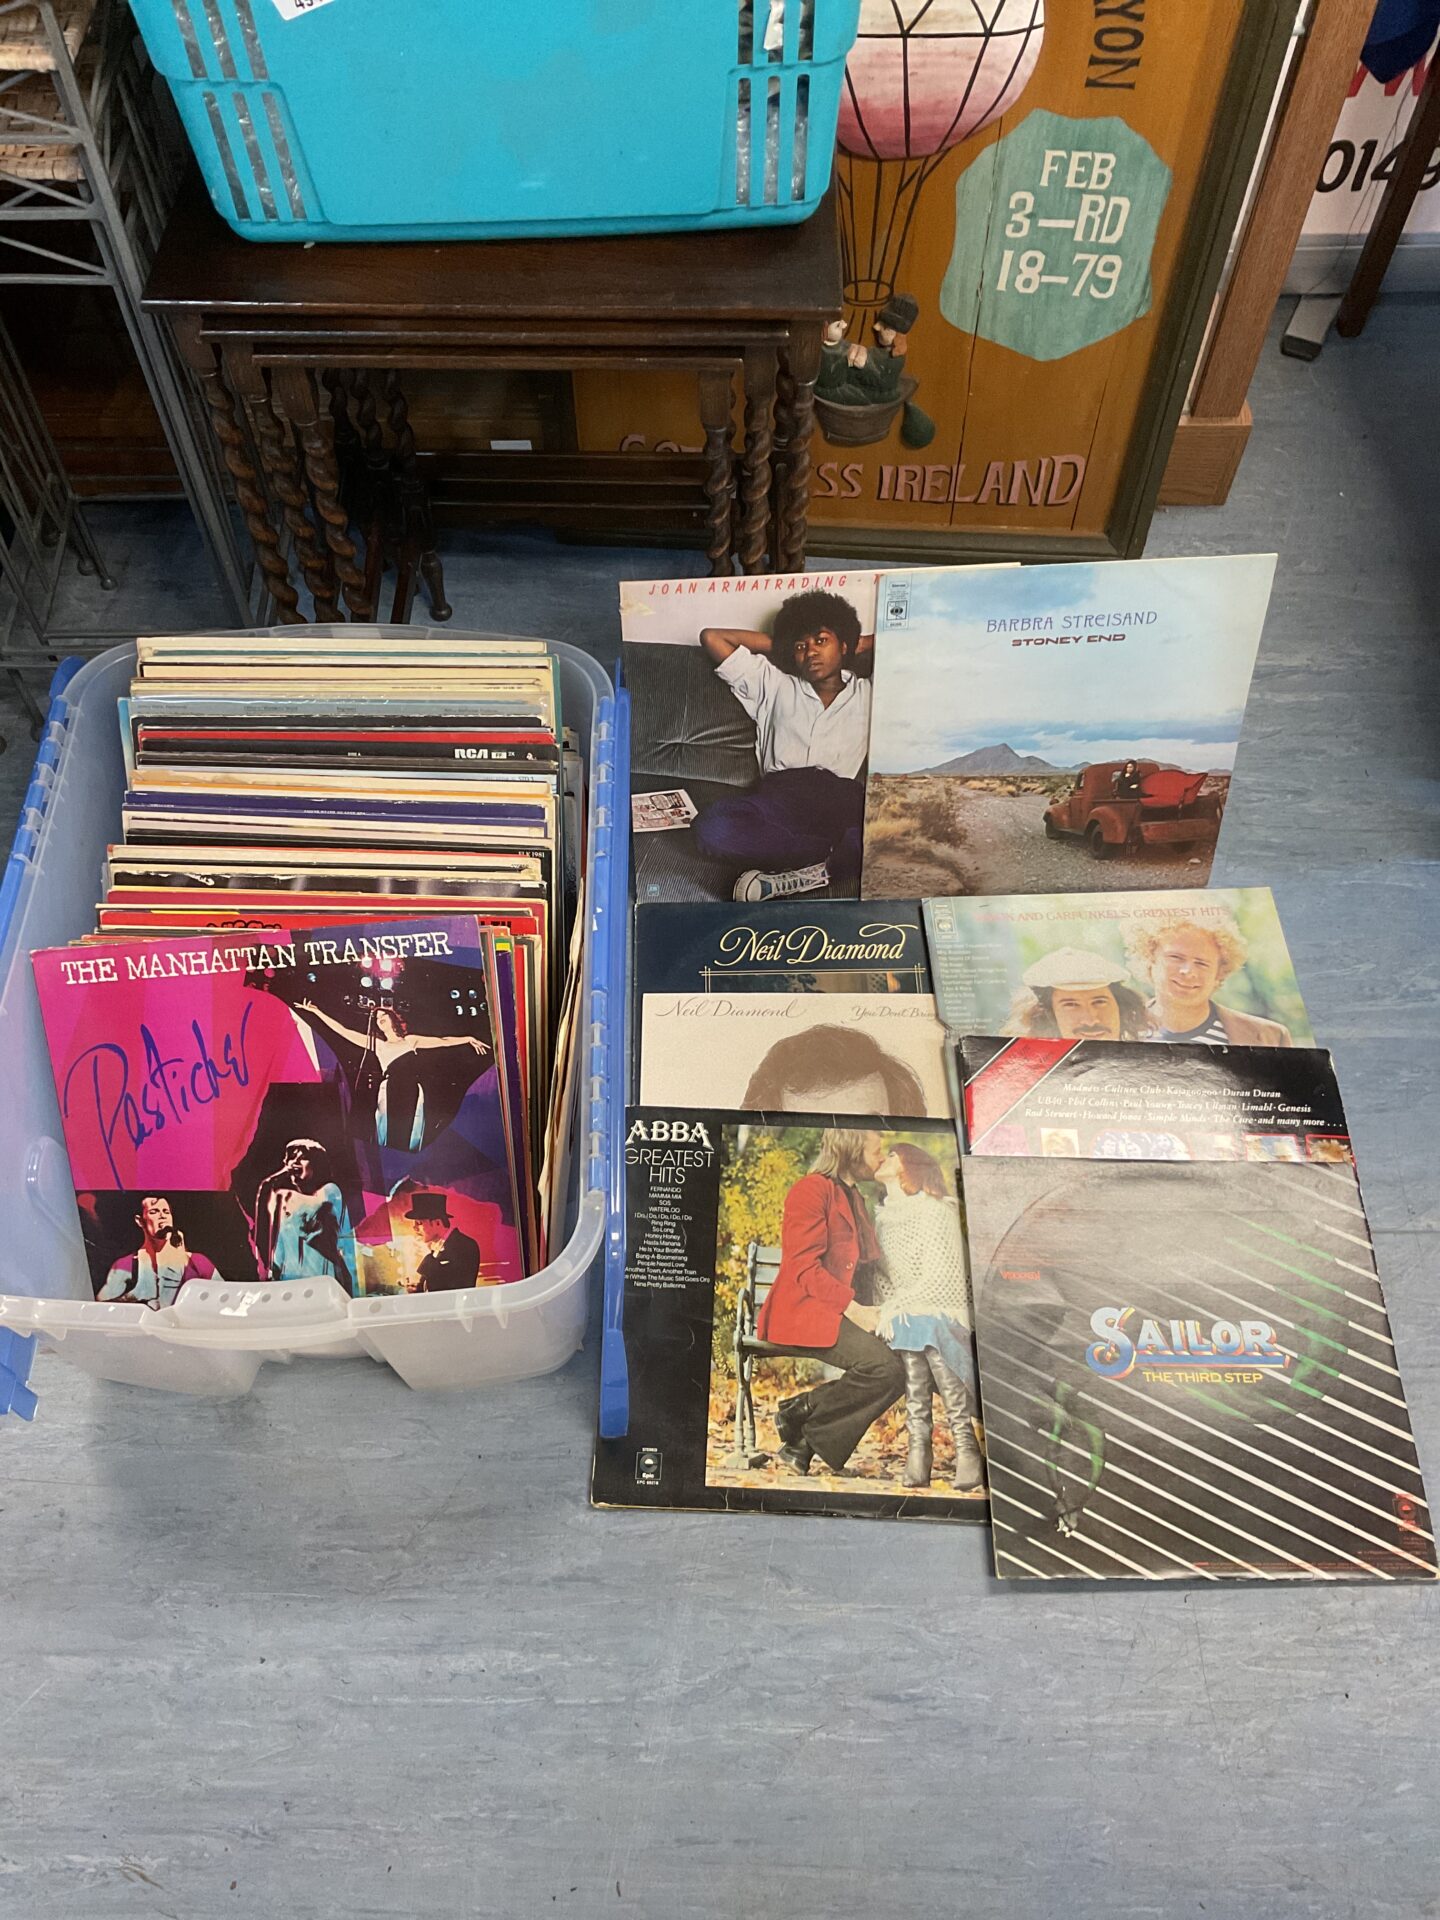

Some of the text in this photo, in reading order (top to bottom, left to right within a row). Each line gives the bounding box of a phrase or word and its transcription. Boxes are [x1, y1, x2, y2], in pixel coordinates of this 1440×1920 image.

[1084, 0, 1146, 90] YON
[1039, 150, 1117, 190] FEB
[810, 454, 1086, 507] SS IRELAND
[649, 582, 698, 596] JOAN
[708, 575, 847, 593] ARMATRADING
[986, 611, 1158, 633] BARBRA STREISAND
[1012, 633, 1126, 647] STONEY END
[454, 748, 489, 759] RCA
[714, 923, 919, 967] Neil Diamond
[60, 931, 453, 985] THE MANHATTAN TRANSFER
[655, 996, 709, 1017] Neil
[712, 998, 807, 1019] Diamond
[851, 1005, 876, 1021] You
[1140, 1084, 1161, 1094] Club
[1222, 1088, 1251, 1097] Duran
[1252, 1088, 1281, 1098] Duran
[1241, 1102, 1273, 1112] Limahl
[1277, 1103, 1312, 1113] Genesis
[1257, 1115, 1275, 1125] and
[1276, 1118, 1301, 1127] many
[625, 1119, 715, 1151] ABBA
[624, 1148, 715, 1168] GREATEST
[649, 1166, 686, 1184] HITS
[662, 1233, 681, 1241] Honey
[1086, 1306, 1286, 1380] SAILOR
[1142, 1371, 1264, 1384] THE THIRD STEP
